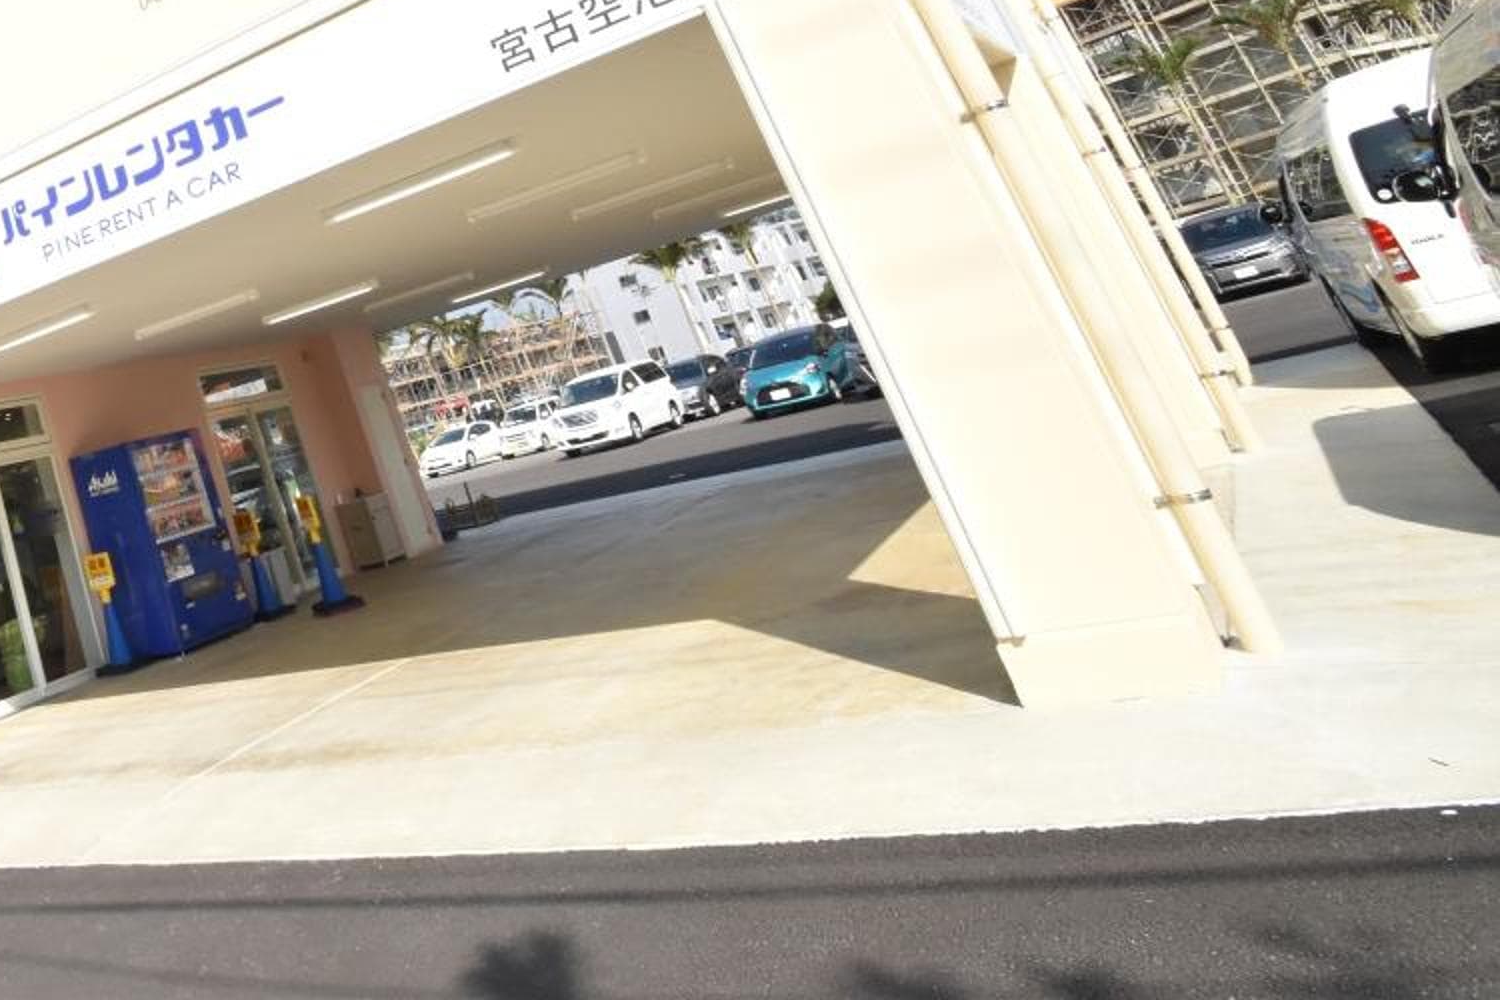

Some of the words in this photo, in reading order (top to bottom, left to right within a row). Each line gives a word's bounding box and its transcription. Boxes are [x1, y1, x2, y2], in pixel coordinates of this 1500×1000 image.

[0, 95, 285, 245] パインレンタカー
[41, 225, 95, 263] PINE
[98, 196, 157, 238] RENT
[166, 189, 184, 210] A
[186, 161, 242, 199] CAR
